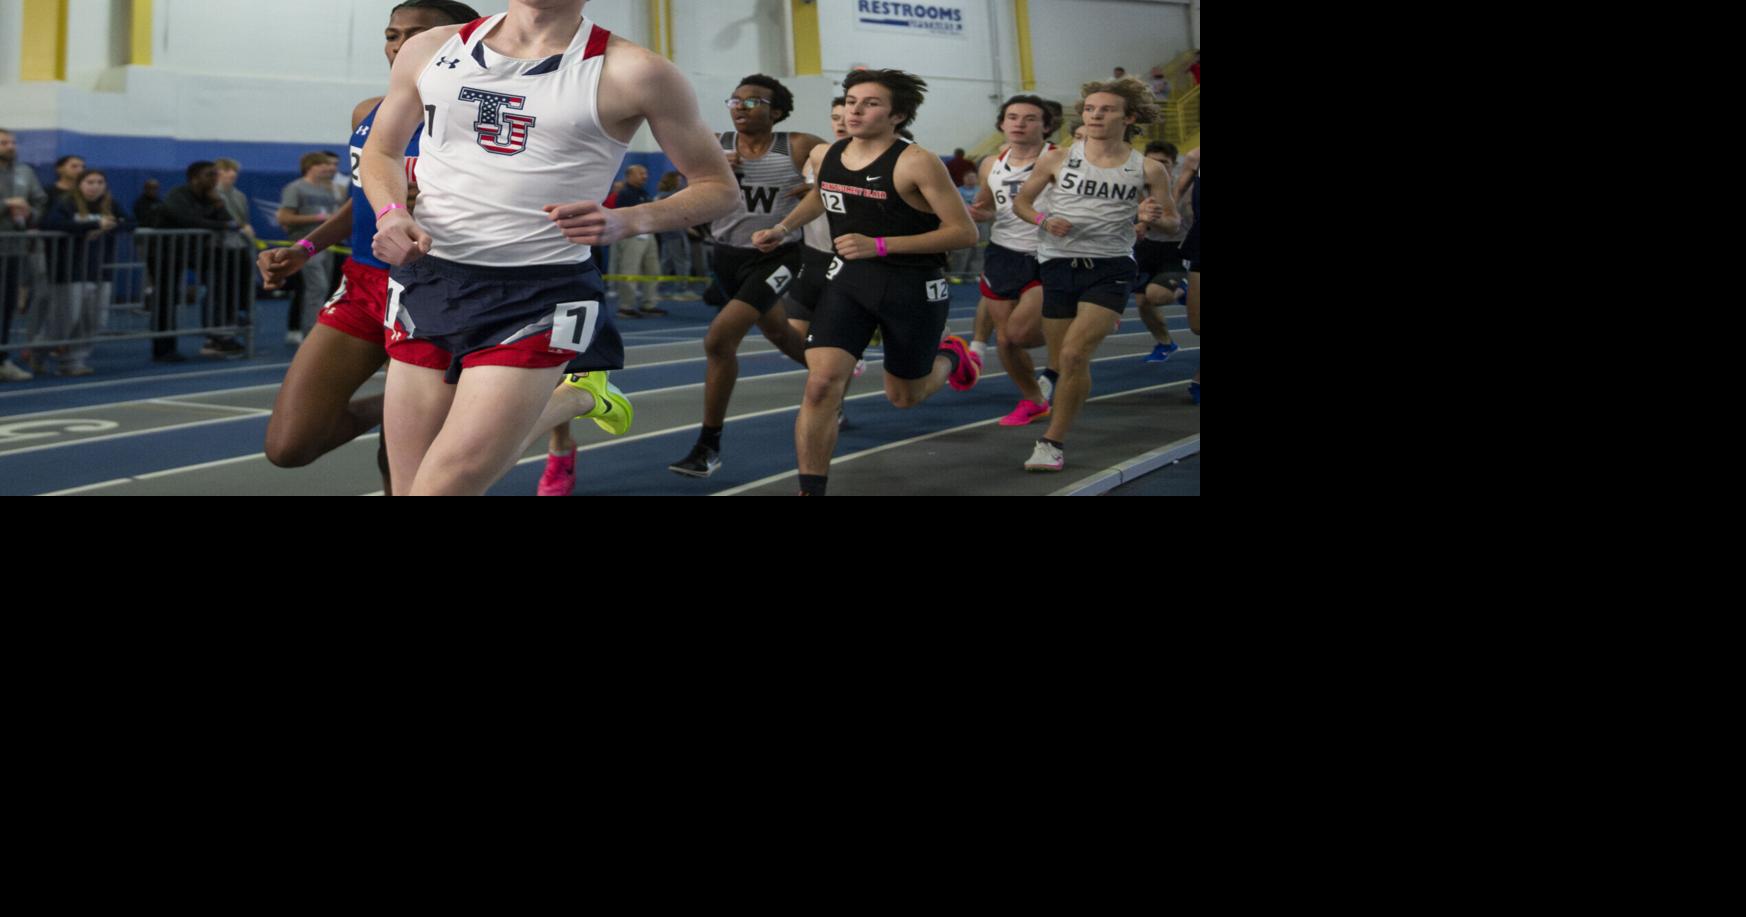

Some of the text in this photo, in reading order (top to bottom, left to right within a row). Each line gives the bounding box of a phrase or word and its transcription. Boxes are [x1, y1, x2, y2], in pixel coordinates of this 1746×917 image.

[858, 0, 962, 21] RESTROOMS
[425, 104, 436, 137] 1
[458, 86, 537, 156] TJ
[1061, 172, 1078, 190] 5
[1076, 179, 1137, 201] BANA
[822, 192, 843, 211] 12
[995, 189, 1007, 205] 6
[774, 274, 789, 287] 4
[928, 281, 948, 300] 12
[566, 306, 587, 344] 1
